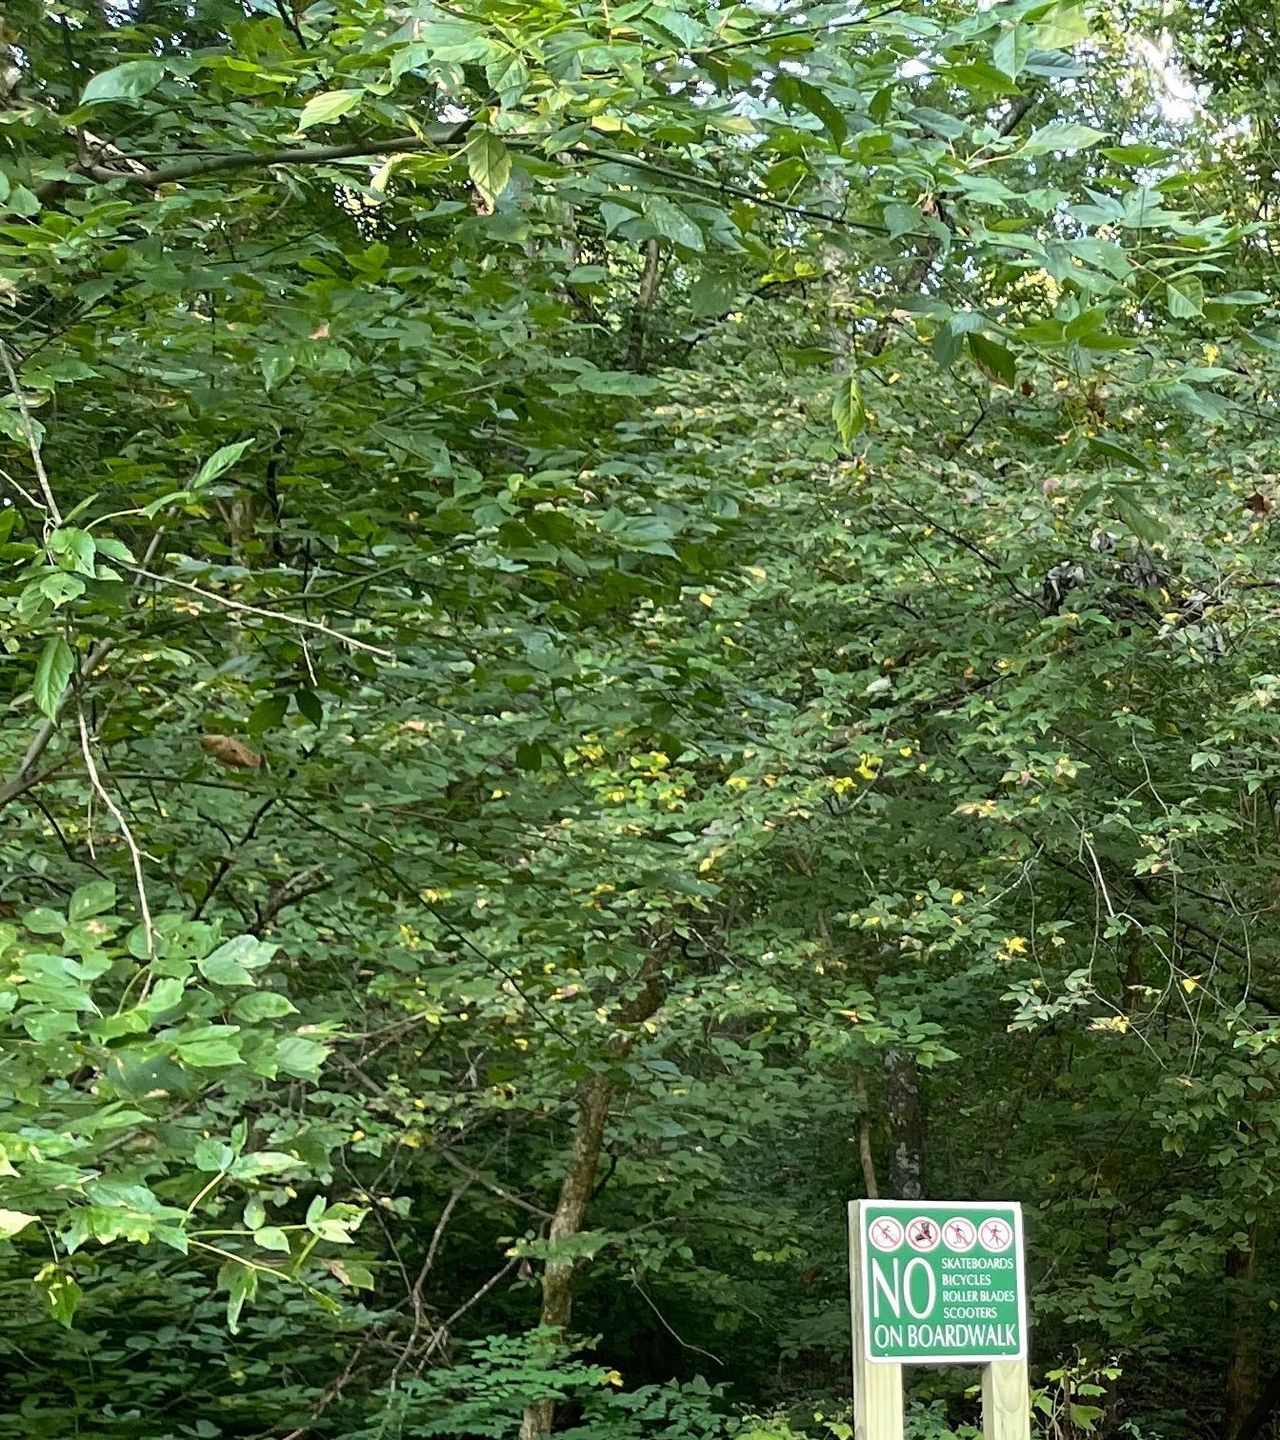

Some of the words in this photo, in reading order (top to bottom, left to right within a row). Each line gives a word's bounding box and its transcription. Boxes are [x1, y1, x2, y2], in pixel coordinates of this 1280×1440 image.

[941, 1257, 1014, 1269] SKATEBOARDS
[941, 1274, 991, 1286] BICYCLES
[872, 1257, 936, 1319] NO
[942, 1290, 978, 1302] ROLLER
[980, 1290, 1015, 1302] BLADES
[943, 1307, 997, 1319] SCOOTERS
[874, 1324, 902, 1348] ON
[908, 1323, 1016, 1348] BOARDWALK
